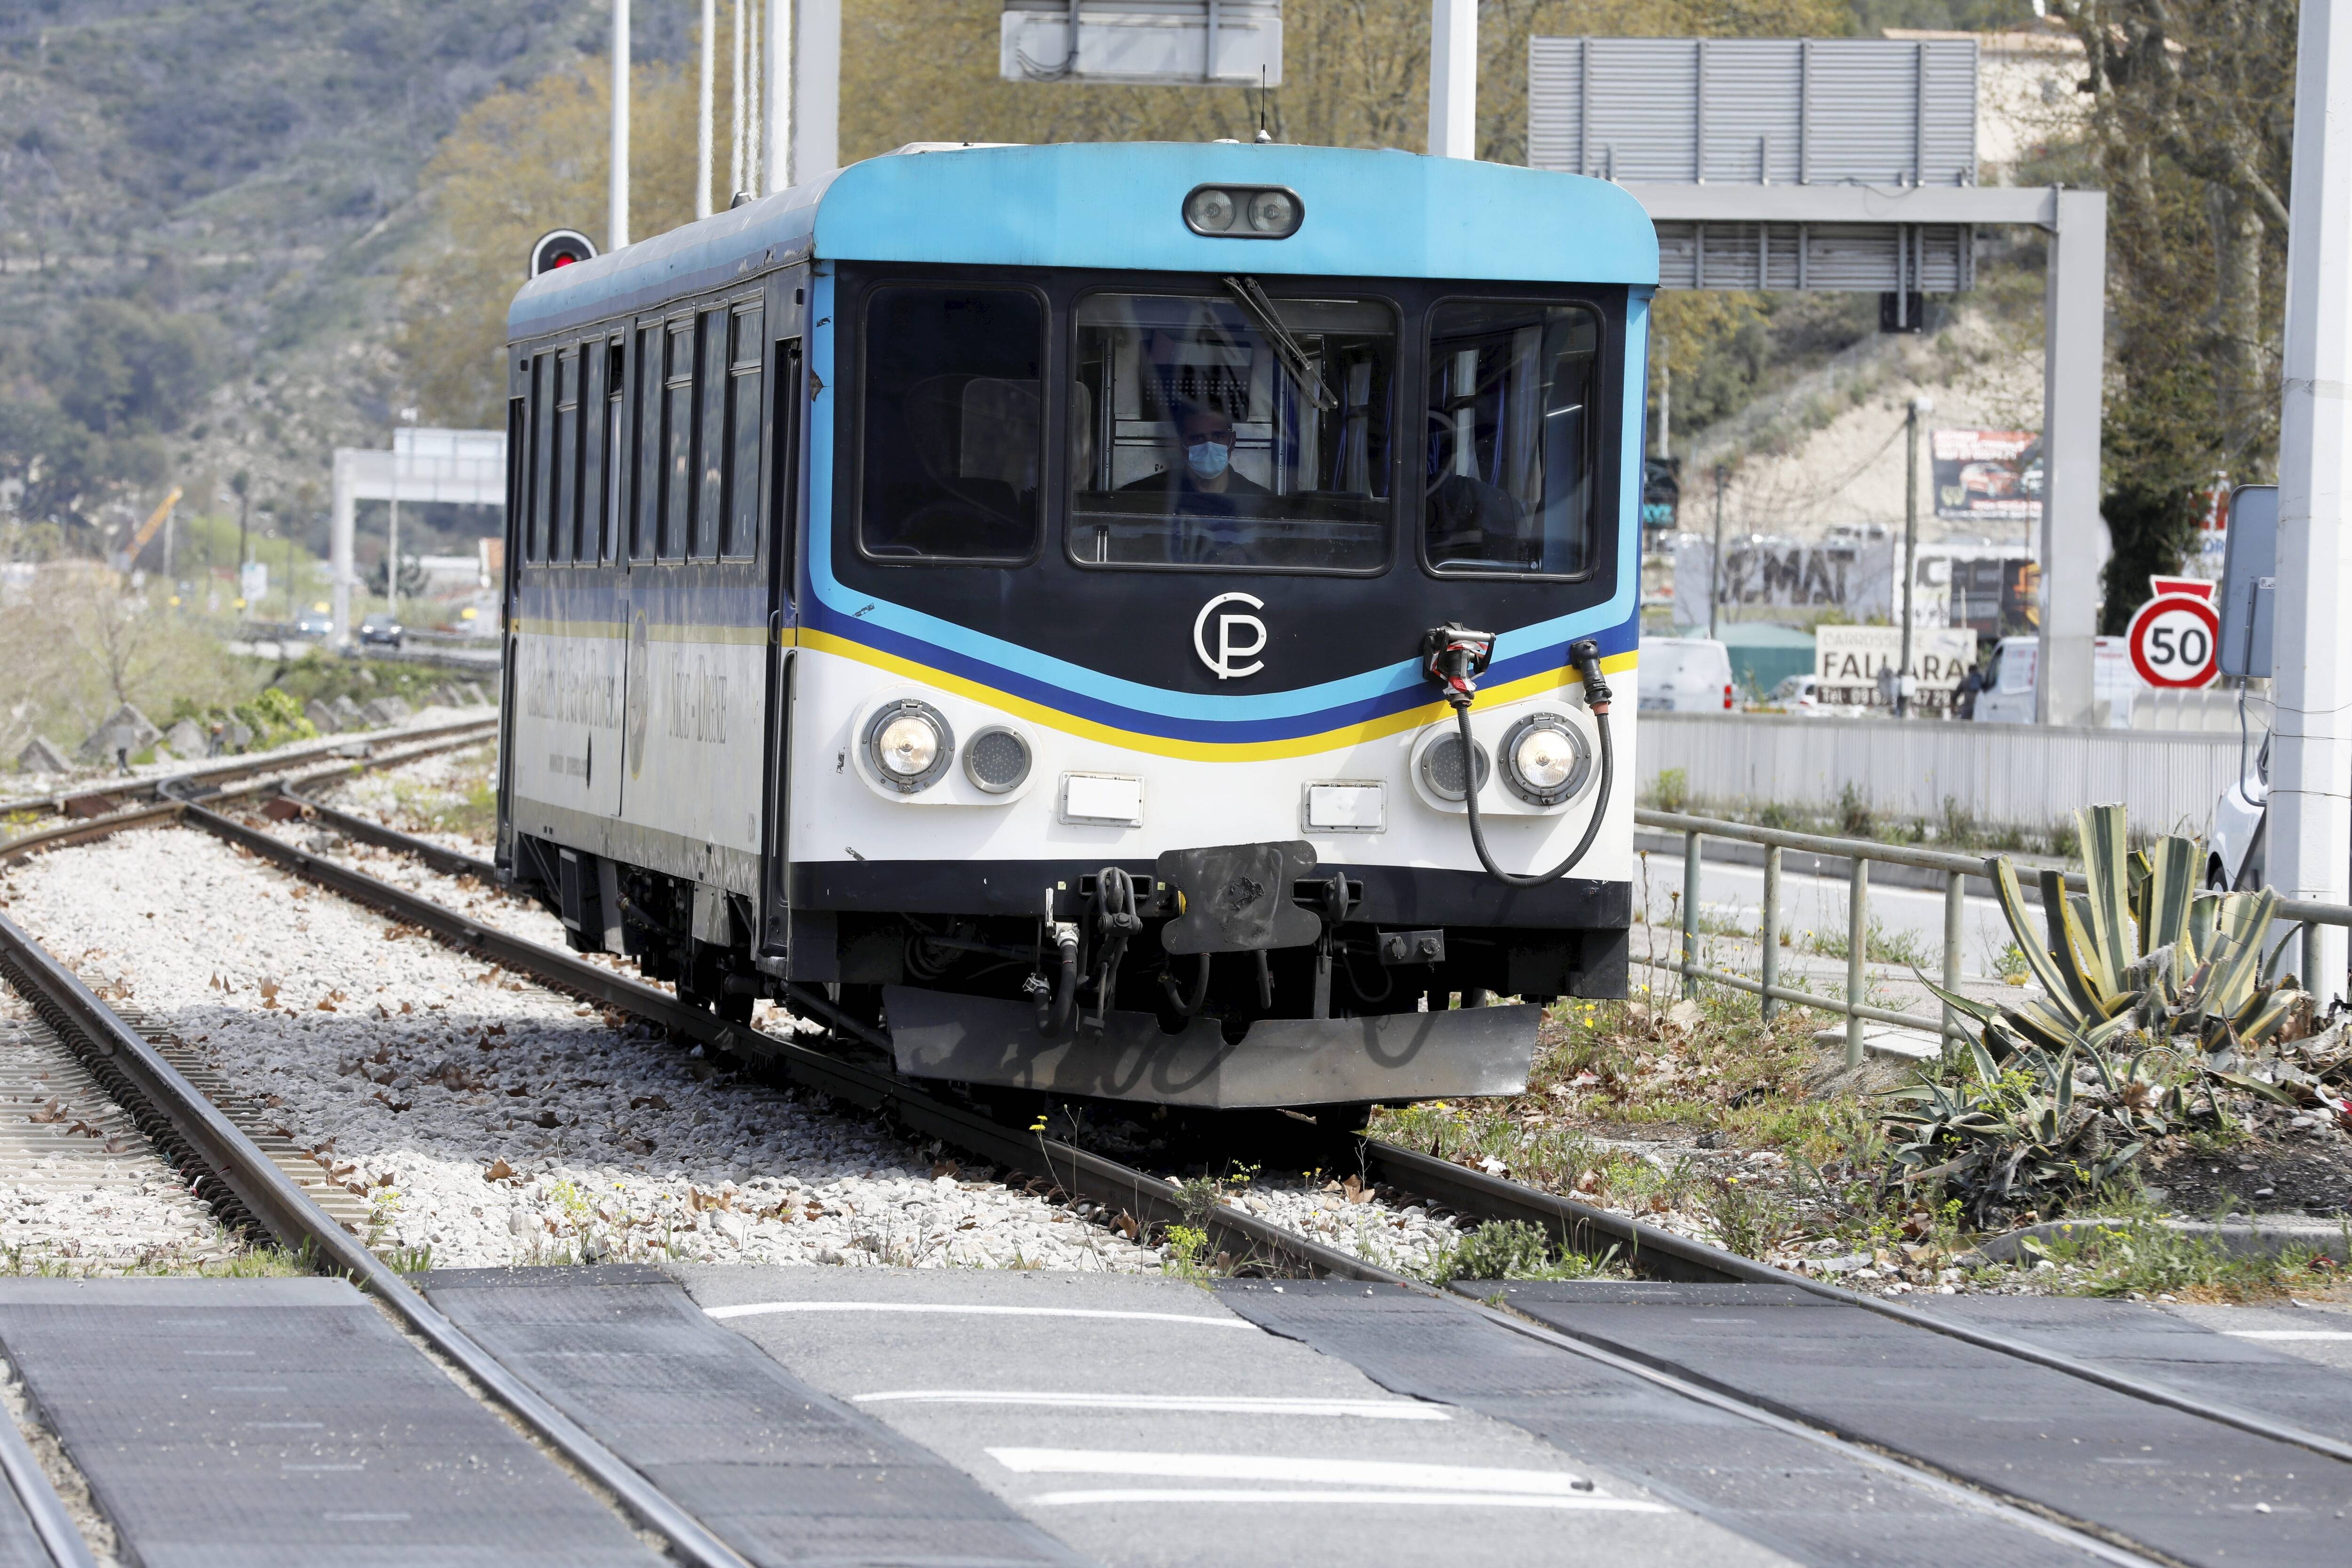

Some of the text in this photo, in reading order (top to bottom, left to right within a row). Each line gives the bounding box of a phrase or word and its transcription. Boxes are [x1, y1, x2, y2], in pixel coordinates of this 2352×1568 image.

[1194, 592, 1267, 680] CP
[2150, 627, 2207, 666] 50
[669, 652, 690, 740] NICE
[697, 654, 727, 744] DIGNE
